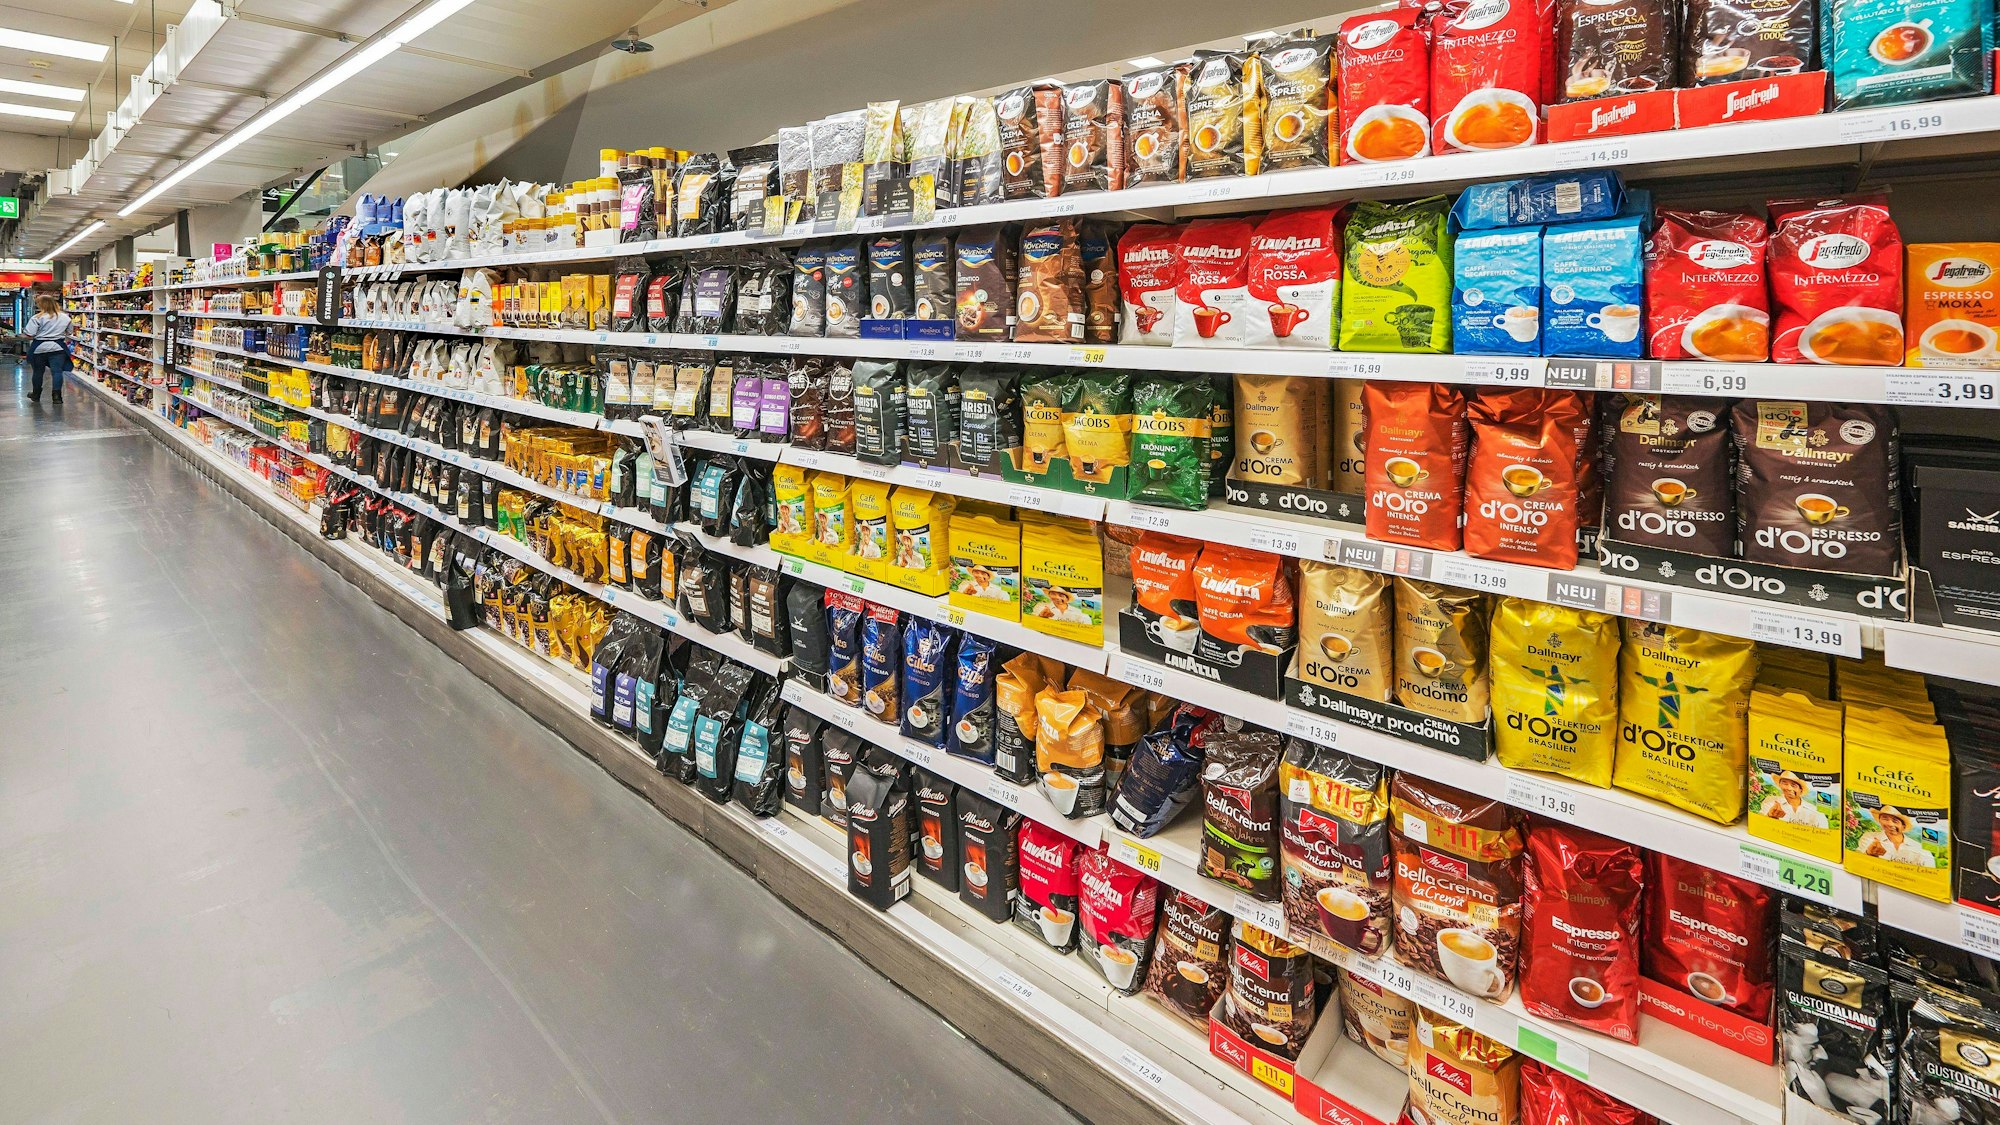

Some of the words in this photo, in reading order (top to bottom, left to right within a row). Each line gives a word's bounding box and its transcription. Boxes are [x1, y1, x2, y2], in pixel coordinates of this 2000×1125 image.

[1577, 7, 1637, 27] ESPRESSO
[1611, 14, 1647, 28] CASA
[1722, 84, 1780, 120] Segafredo
[1132, 108, 1163, 121] CREMA
[1588, 99, 1638, 134] Segafredo
[1889, 115, 1943, 132] 16,99
[1066, 118, 1091, 130] CREMA
[1591, 149, 1629, 162] 14,99
[1384, 169, 1416, 182] 12,99
[1183, 244, 1242, 258] LAVAZZA
[1257, 236, 1322, 251] LAVAZZA
[1807, 240, 1864, 262] Segafredo
[1263, 268, 1308, 281] ROSSA
[1553, 264, 1612, 275] DECAFFEINATO
[1681, 270, 1760, 285] INTERMEZZO
[1190, 273, 1229, 285] ROSSA
[1794, 271, 1880, 287] INTERMEZZO
[324, 280, 334, 320] STARBUCKS
[1923, 290, 1994, 301] ESPRESSO
[1937, 299, 1983, 309] MOKA
[166, 327, 175, 364] STARBUCKS
[966, 350, 983, 359] 13,99
[1014, 351, 1032, 360] 13,99
[1084, 353, 1105, 365] 9,99
[1352, 363, 1382, 375] 16,99
[1494, 367, 1530, 381] 9,99
[1546, 366, 1588, 382] NEU!
[1702, 374, 1747, 391] 6,99
[1938, 382, 1994, 402] 3,99
[960, 400, 994, 415] BARISTA
[1245, 403, 1280, 415] Dallmayr
[1073, 416, 1111, 429] JACOBS
[1137, 419, 1186, 433] JACOBS
[1380, 424, 1425, 438] Dallmayr
[1077, 439, 1099, 448] CREMA
[1140, 442, 1177, 454] KRÖNUNG
[1638, 434, 1697, 449] Dallmayr
[1240, 458, 1283, 477] d'Oro
[1264, 456, 1295, 465] CREMA
[1796, 460, 1837, 468] RÖSTKUNST
[1023, 495, 1041, 507] 12,99
[1278, 493, 1328, 514] d'Oro
[1372, 489, 1428, 515] d'Oro
[1405, 489, 1442, 500] CREMA
[899, 502, 916, 512] Café
[1480, 499, 1548, 527] d'Oro
[1523, 500, 1564, 512] CREMA
[1666, 508, 1725, 522] ESPRESSO
[1147, 515, 1170, 528] 12,99
[1387, 510, 1421, 522] INTENSA
[1617, 509, 1697, 539] d'Oro
[1499, 521, 1539, 535] INTENSA
[1811, 527, 1882, 543] ESPRESSO
[967, 540, 996, 553] Café
[1270, 538, 1298, 552] 13,99
[1754, 525, 1847, 560] d'Oro
[957, 543, 1008, 561] Intención
[1139, 550, 1186, 572] LAVAZZA
[1345, 546, 1377, 562] NEU!
[1942, 551, 2000, 565] ESPRES
[1031, 564, 1089, 582] Intención
[1043, 560, 1076, 573] Café
[903, 573, 917, 583] Café
[1472, 572, 1507, 589] 13,99
[1694, 563, 1786, 596] d'Oro
[1555, 582, 1598, 601] NEU!
[947, 612, 964, 626] 9,99
[1221, 609, 1244, 619] CREMA
[1793, 626, 1843, 646] 13,99
[1527, 644, 1582, 665] Dallmayr
[1641, 646, 1701, 670] Dallmayr
[1164, 652, 1222, 681] LAVAZZA
[1306, 662, 1359, 688] d'Oro
[1337, 664, 1371, 676] CREMA
[1141, 673, 1164, 688] 13,99
[1431, 680, 1467, 692] CREMA
[1399, 677, 1468, 704] prodomo
[1319, 693, 1384, 724] Dallmayr
[1387, 714, 1460, 746] prodomo
[1423, 717, 1460, 735] CREMA
[1506, 710, 1578, 746] d'Oro
[1551, 716, 1602, 734] SELEKTION
[1309, 726, 1337, 743] 13,99
[1622, 723, 1696, 762] d'Oro
[1665, 730, 1724, 751] SELEKTION
[1773, 732, 1811, 750] Café
[824, 748, 850, 761] Alberto
[1528, 736, 1578, 756] BRASILIEN
[1759, 739, 1826, 764] Intención
[1641, 751, 1695, 774] BRASILIEN
[1803, 773, 1833, 782] Espresso
[1873, 765, 1914, 784] Café
[1856, 770, 1932, 799] Intención
[916, 786, 945, 802] Alberto
[1000, 792, 1019, 805] 13,99
[1206, 790, 1271, 833] BellaCrema
[1540, 795, 1576, 816] 13,99
[1906, 807, 1940, 817] Espresso
[959, 810, 993, 832] Alberto
[1021, 836, 1062, 869] LAVAZZA
[1283, 826, 1363, 870] BellaCrema
[1137, 853, 1160, 873] 9,99
[1303, 848, 1342, 871] Intenso
[1424, 853, 1463, 879] Melitta
[1397, 862, 1495, 905] BellaCrema
[1782, 866, 1832, 898] 4,29
[1411, 883, 1466, 909] laCrema
[1677, 880, 1739, 910] Dallmayr
[1163, 898, 1222, 943] BellaCrema
[1255, 910, 1281, 930] 12,99
[1551, 915, 1621, 943] Espresso
[1669, 908, 1749, 948] Espresso
[1167, 919, 1197, 946] Espresso
[1684, 928, 1732, 953] intenso
[1312, 938, 1348, 964] Intenso
[1565, 935, 1608, 952] intenso
[1668, 934, 1691, 953] kräftig
[1692, 942, 1704, 953] und
[1705, 947, 1746, 971] aromatisch
[1573, 950, 1584, 960] und
[1584, 951, 1619, 964] aromatisch
[1381, 968, 1412, 993] 12,99
[1012, 981, 1033, 999] 13,99
[1441, 994, 1475, 1020] 12,99
[1788, 991, 1878, 1029] GUSTOITALIANO
[1687, 1009, 1745, 1043] intenso
[1218, 1040, 1245, 1064] Melitta
[1138, 1065, 1163, 1084] 12,99
[1256, 1063, 1281, 1083] +111
[1430, 1062, 1468, 1090] Melitta
[1410, 1066, 1499, 1123] BellaCrema
